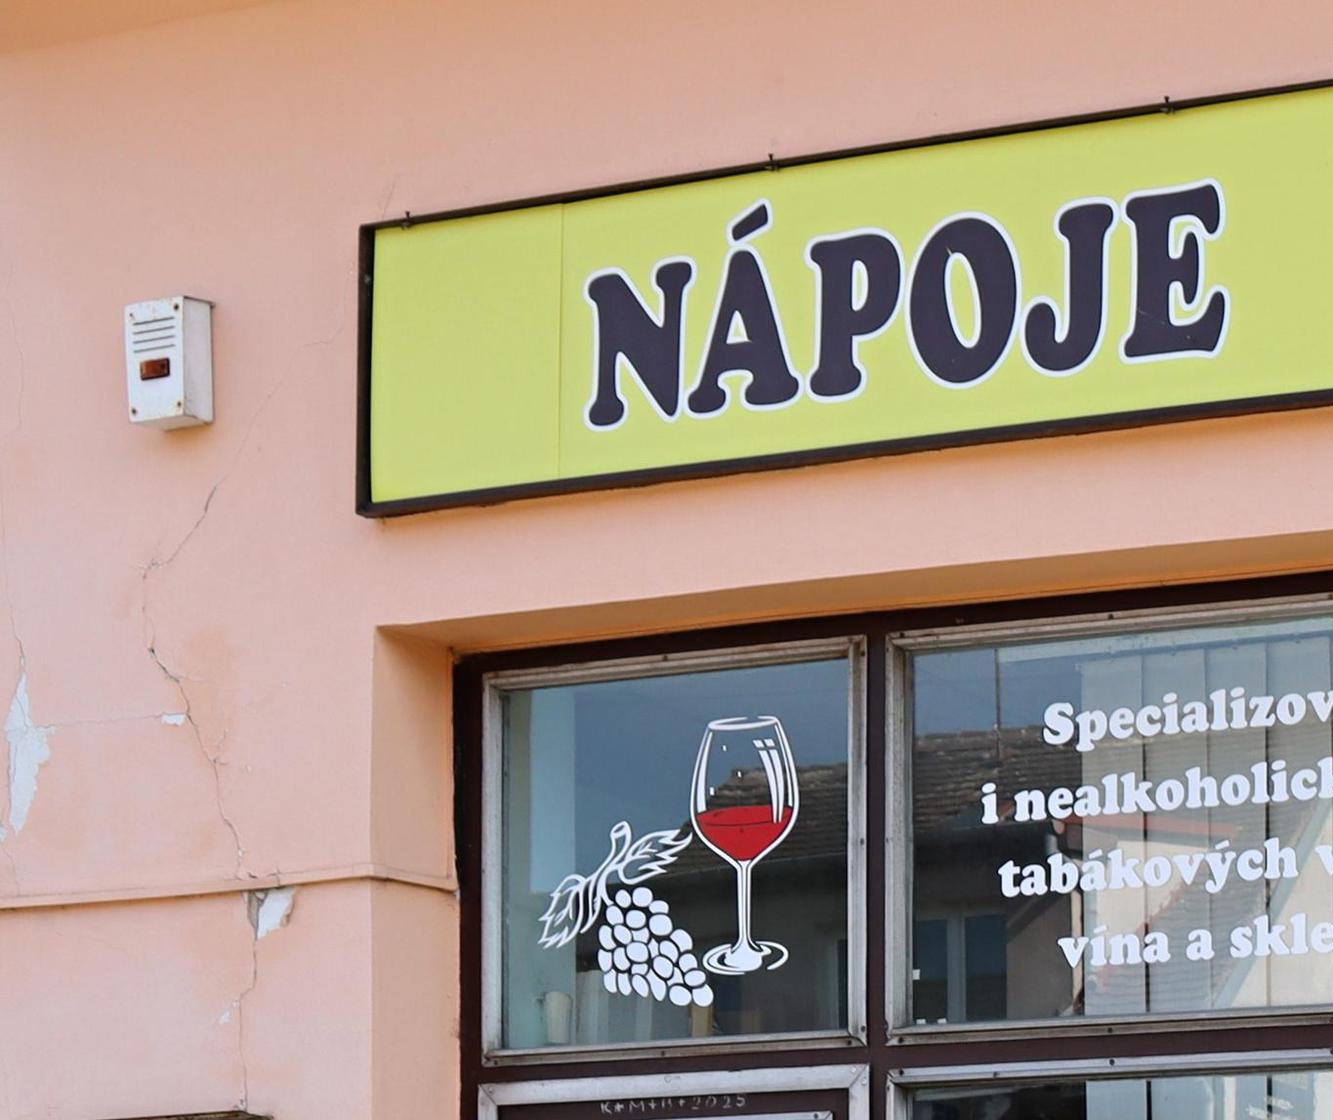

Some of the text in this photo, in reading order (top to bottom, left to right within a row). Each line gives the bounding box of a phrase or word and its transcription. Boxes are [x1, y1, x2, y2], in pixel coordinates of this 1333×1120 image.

[586, 180, 1228, 430] NÁPOJE
[980, 784, 999, 825] i
[998, 826, 1298, 899] tabákových
[1058, 923, 1171, 970] vína
[1187, 927, 1215, 962] a
